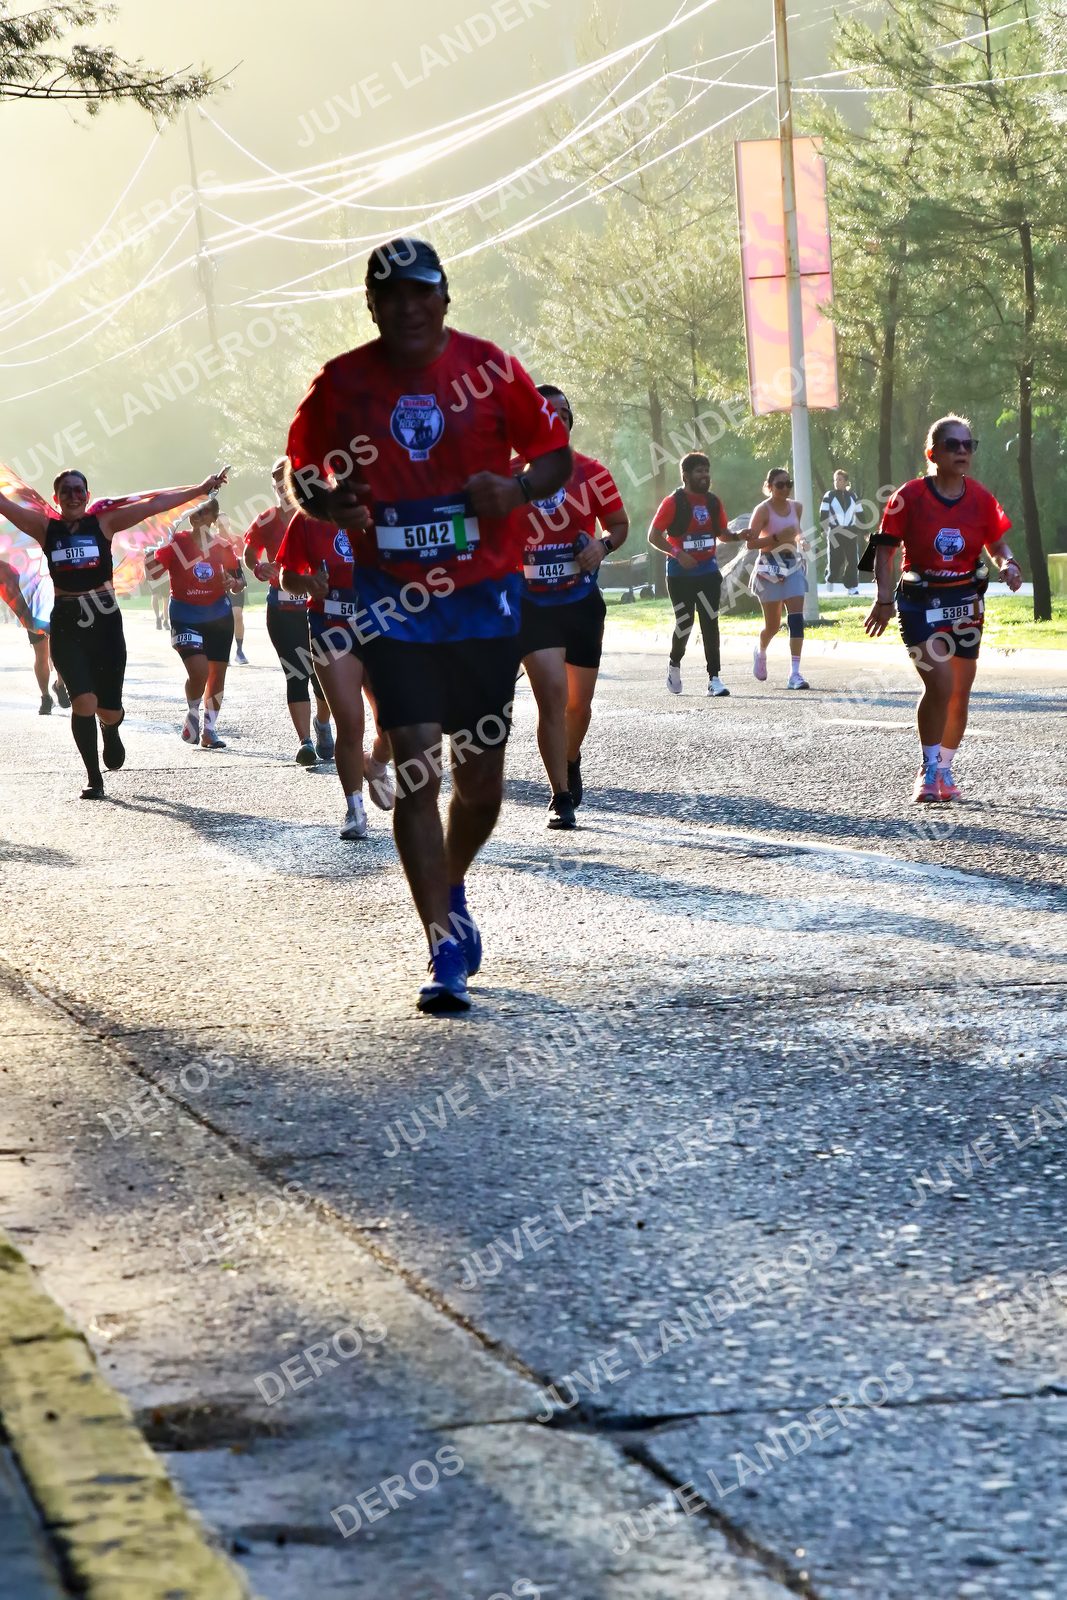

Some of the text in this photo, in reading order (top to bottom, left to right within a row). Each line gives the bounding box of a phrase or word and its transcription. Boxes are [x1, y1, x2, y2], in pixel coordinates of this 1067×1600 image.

[404, 523, 450, 547] 5042
[65, 548, 85, 559] 5175
[539, 564, 565, 577] 4442
[341, 603, 353, 615] 54
[943, 606, 969, 619] 5389
